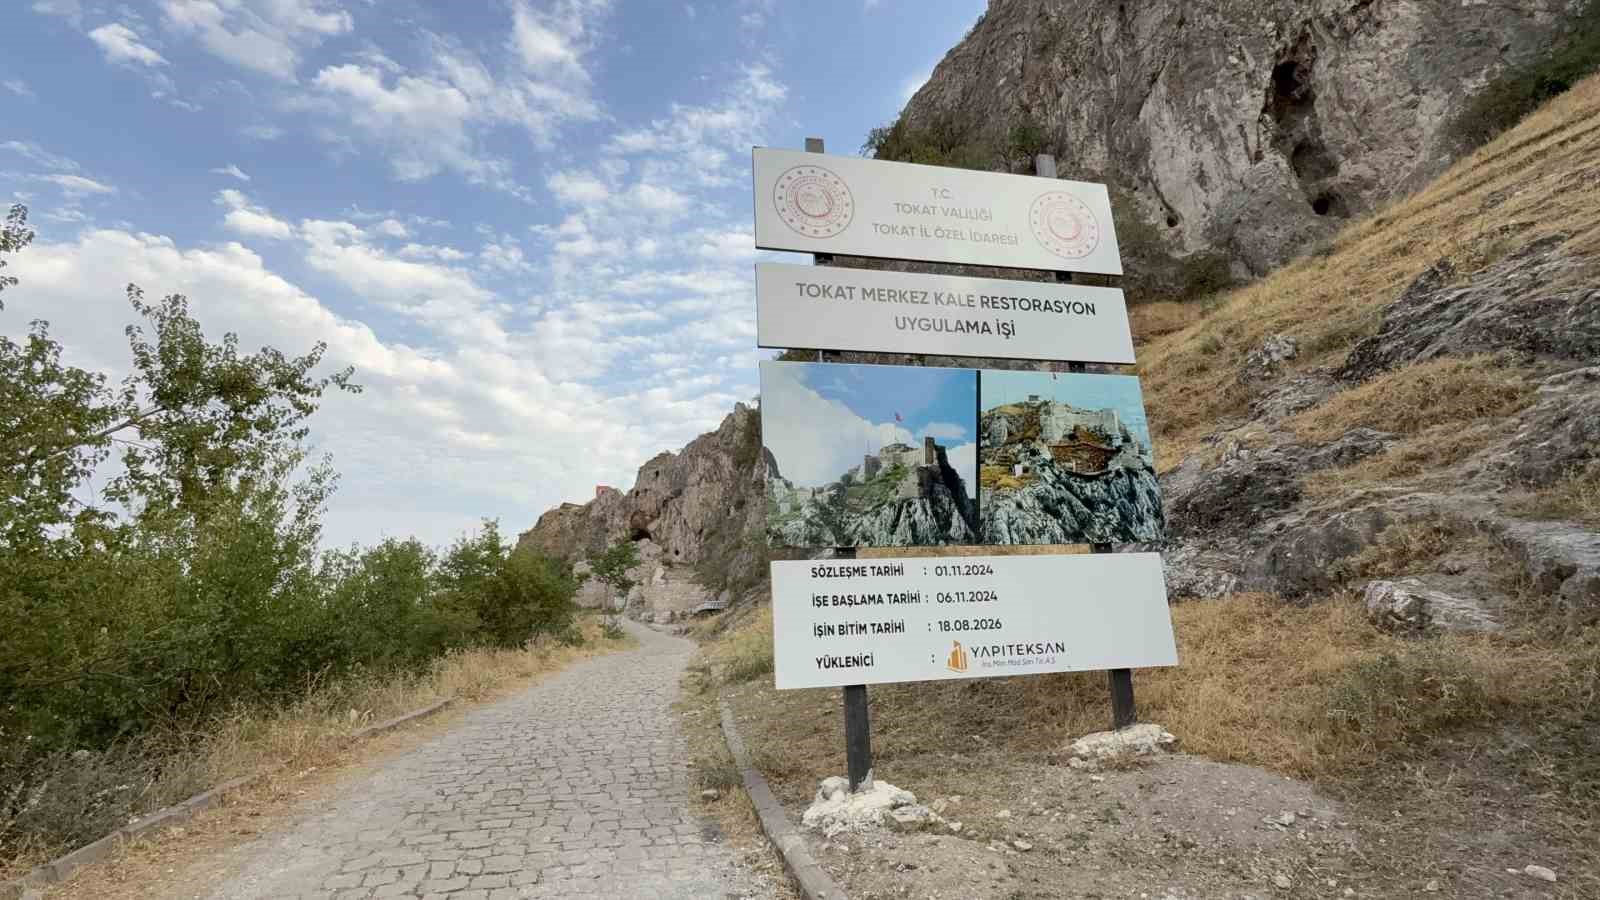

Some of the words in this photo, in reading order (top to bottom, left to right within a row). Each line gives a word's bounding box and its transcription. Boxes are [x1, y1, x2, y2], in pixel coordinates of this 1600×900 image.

[893, 202, 937, 216] TOKAT
[940, 205, 993, 222] VALİLİĞİ
[872, 222, 917, 237] TOKAT
[919, 223, 932, 238] İL
[934, 225, 967, 241] ÖZEL
[969, 227, 1018, 246] İDARESİ
[795, 282, 857, 300] TOKAT
[861, 287, 930, 305] MERKEZ
[933, 290, 976, 308] KALE
[980, 295, 1096, 316] RESTORASYON
[895, 316, 992, 335] UYGULAMA
[996, 318, 1016, 340] İŞİ
[811, 564, 867, 579] SÖZLEŞME
[870, 562, 904, 577] TARİHİ
[935, 565, 994, 576] 01.11.2024
[812, 592, 829, 608] İŞE
[832, 594, 884, 608] BAŞLAMA
[886, 589, 921, 605] TARİHİ
[936, 591, 998, 603] 06.11.2024
[813, 622, 835, 639] İŞİN
[838, 620, 867, 636] BİTİM
[870, 618, 905, 635] TARİHİ
[938, 618, 1002, 632] 18.08.2026
[815, 652, 874, 669] YÜKLENİCİ
